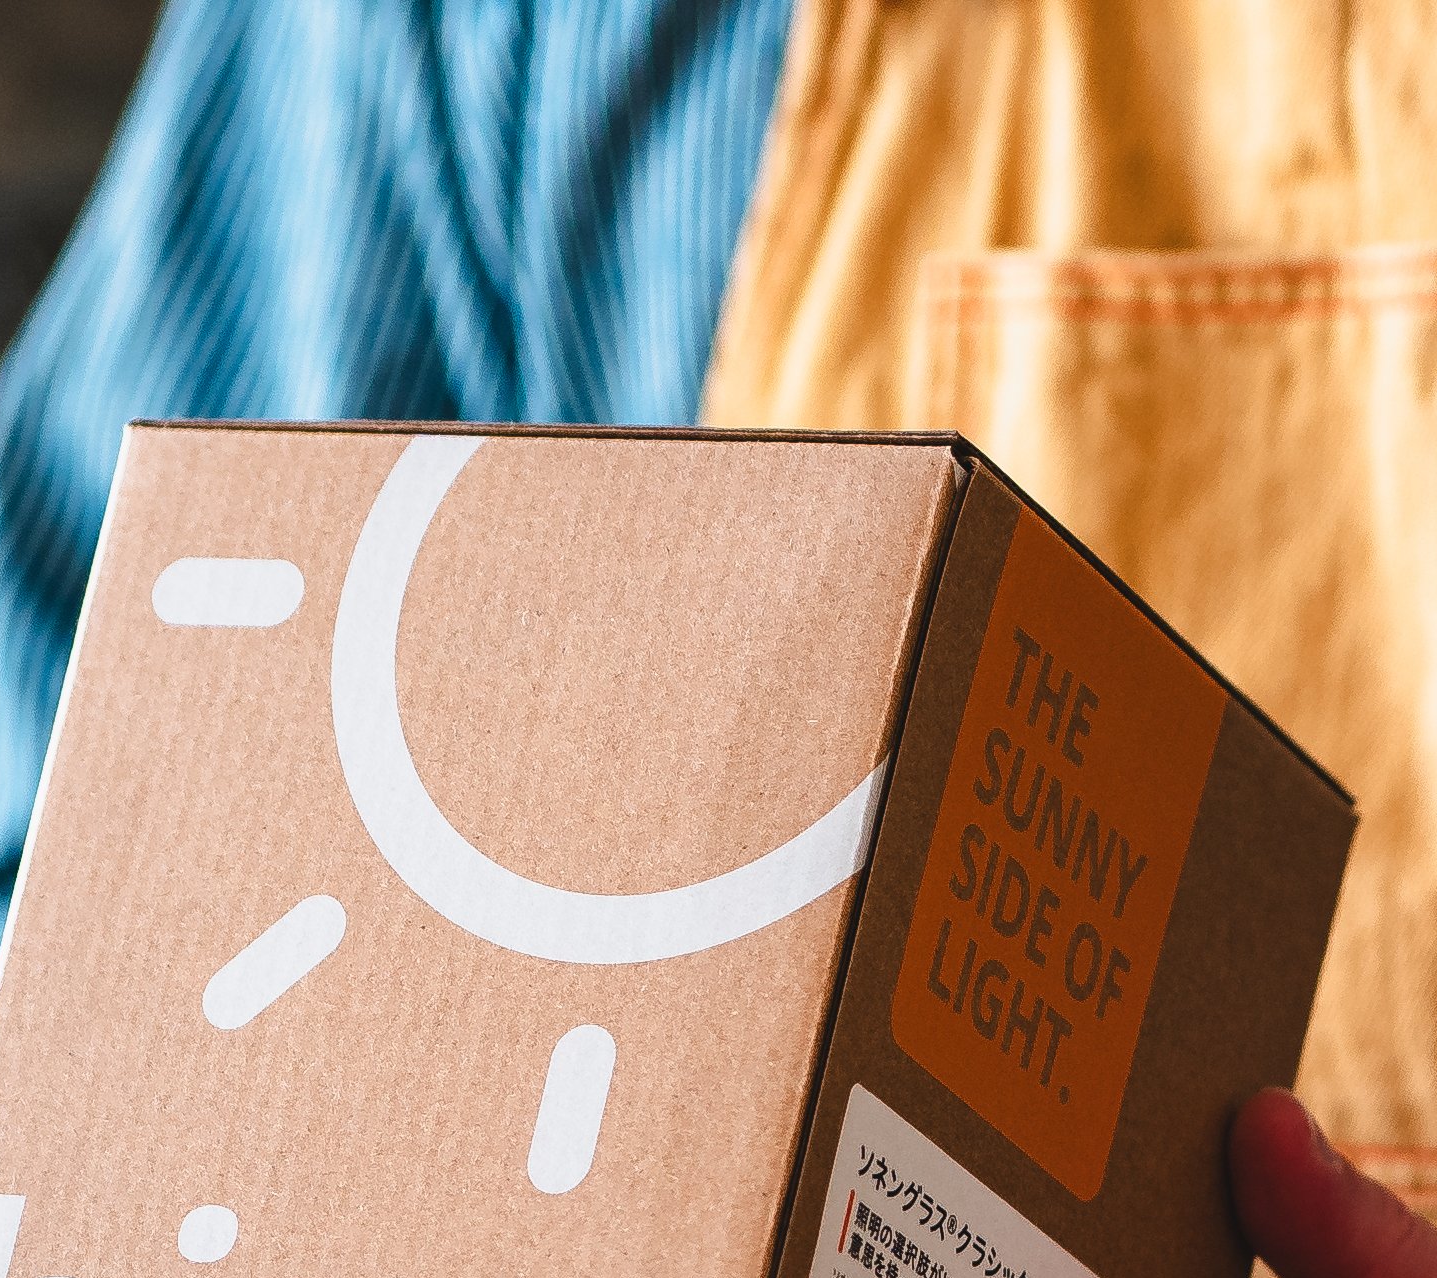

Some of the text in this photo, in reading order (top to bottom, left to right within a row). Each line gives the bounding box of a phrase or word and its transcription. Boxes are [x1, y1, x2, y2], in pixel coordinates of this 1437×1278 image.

[1008, 626, 1102, 772] THE
[971, 729, 1150, 921] SUNNY
[944, 822, 1133, 1024] SIDE OF
[923, 947, 1074, 1104] LIGHT.
